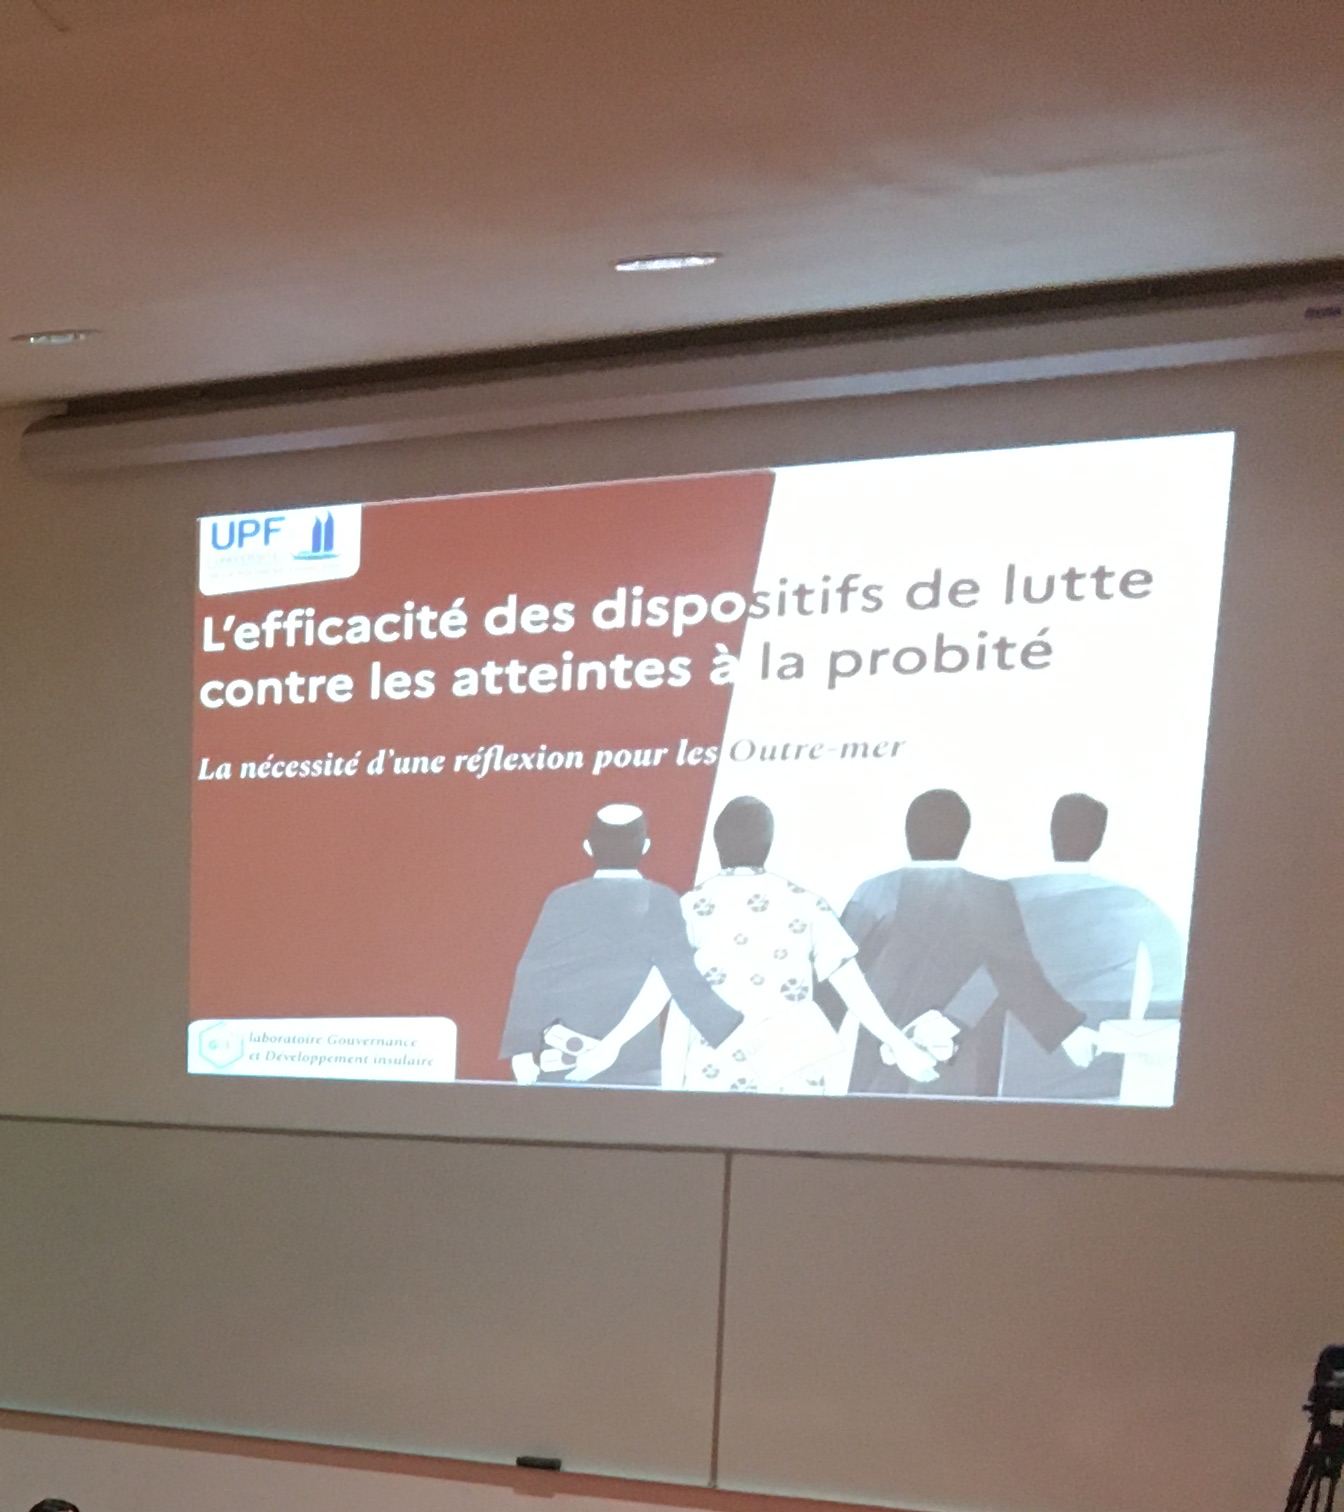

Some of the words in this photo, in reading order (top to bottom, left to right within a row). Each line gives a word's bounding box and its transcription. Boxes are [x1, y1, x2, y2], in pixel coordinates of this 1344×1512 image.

[211, 516, 286, 550] UPF
[201, 597, 468, 652] L'efficacité
[484, 594, 575, 636] des
[591, 573, 884, 637] dispositifs
[906, 568, 981, 610] de
[1004, 563, 1154, 605] lutte
[199, 671, 354, 709] contre
[370, 661, 436, 700] les
[452, 651, 693, 696] atteintes
[709, 643, 740, 685] à
[761, 642, 806, 680] la
[827, 627, 1054, 690] probité
[198, 757, 232, 781] La
[240, 753, 363, 779] nécessité
[367, 749, 445, 776] d'une
[453, 744, 584, 780] réflexion
[592, 748, 668, 775] pour
[676, 738, 719, 766] les
[729, 738, 907, 761] Outre-mer
[248, 1031, 322, 1045] laboratoire
[327, 1034, 418, 1048] Gouvernance
[248, 1052, 260, 1061] et
[264, 1050, 369, 1066] Développement
[373, 1052, 434, 1067] insulaire
